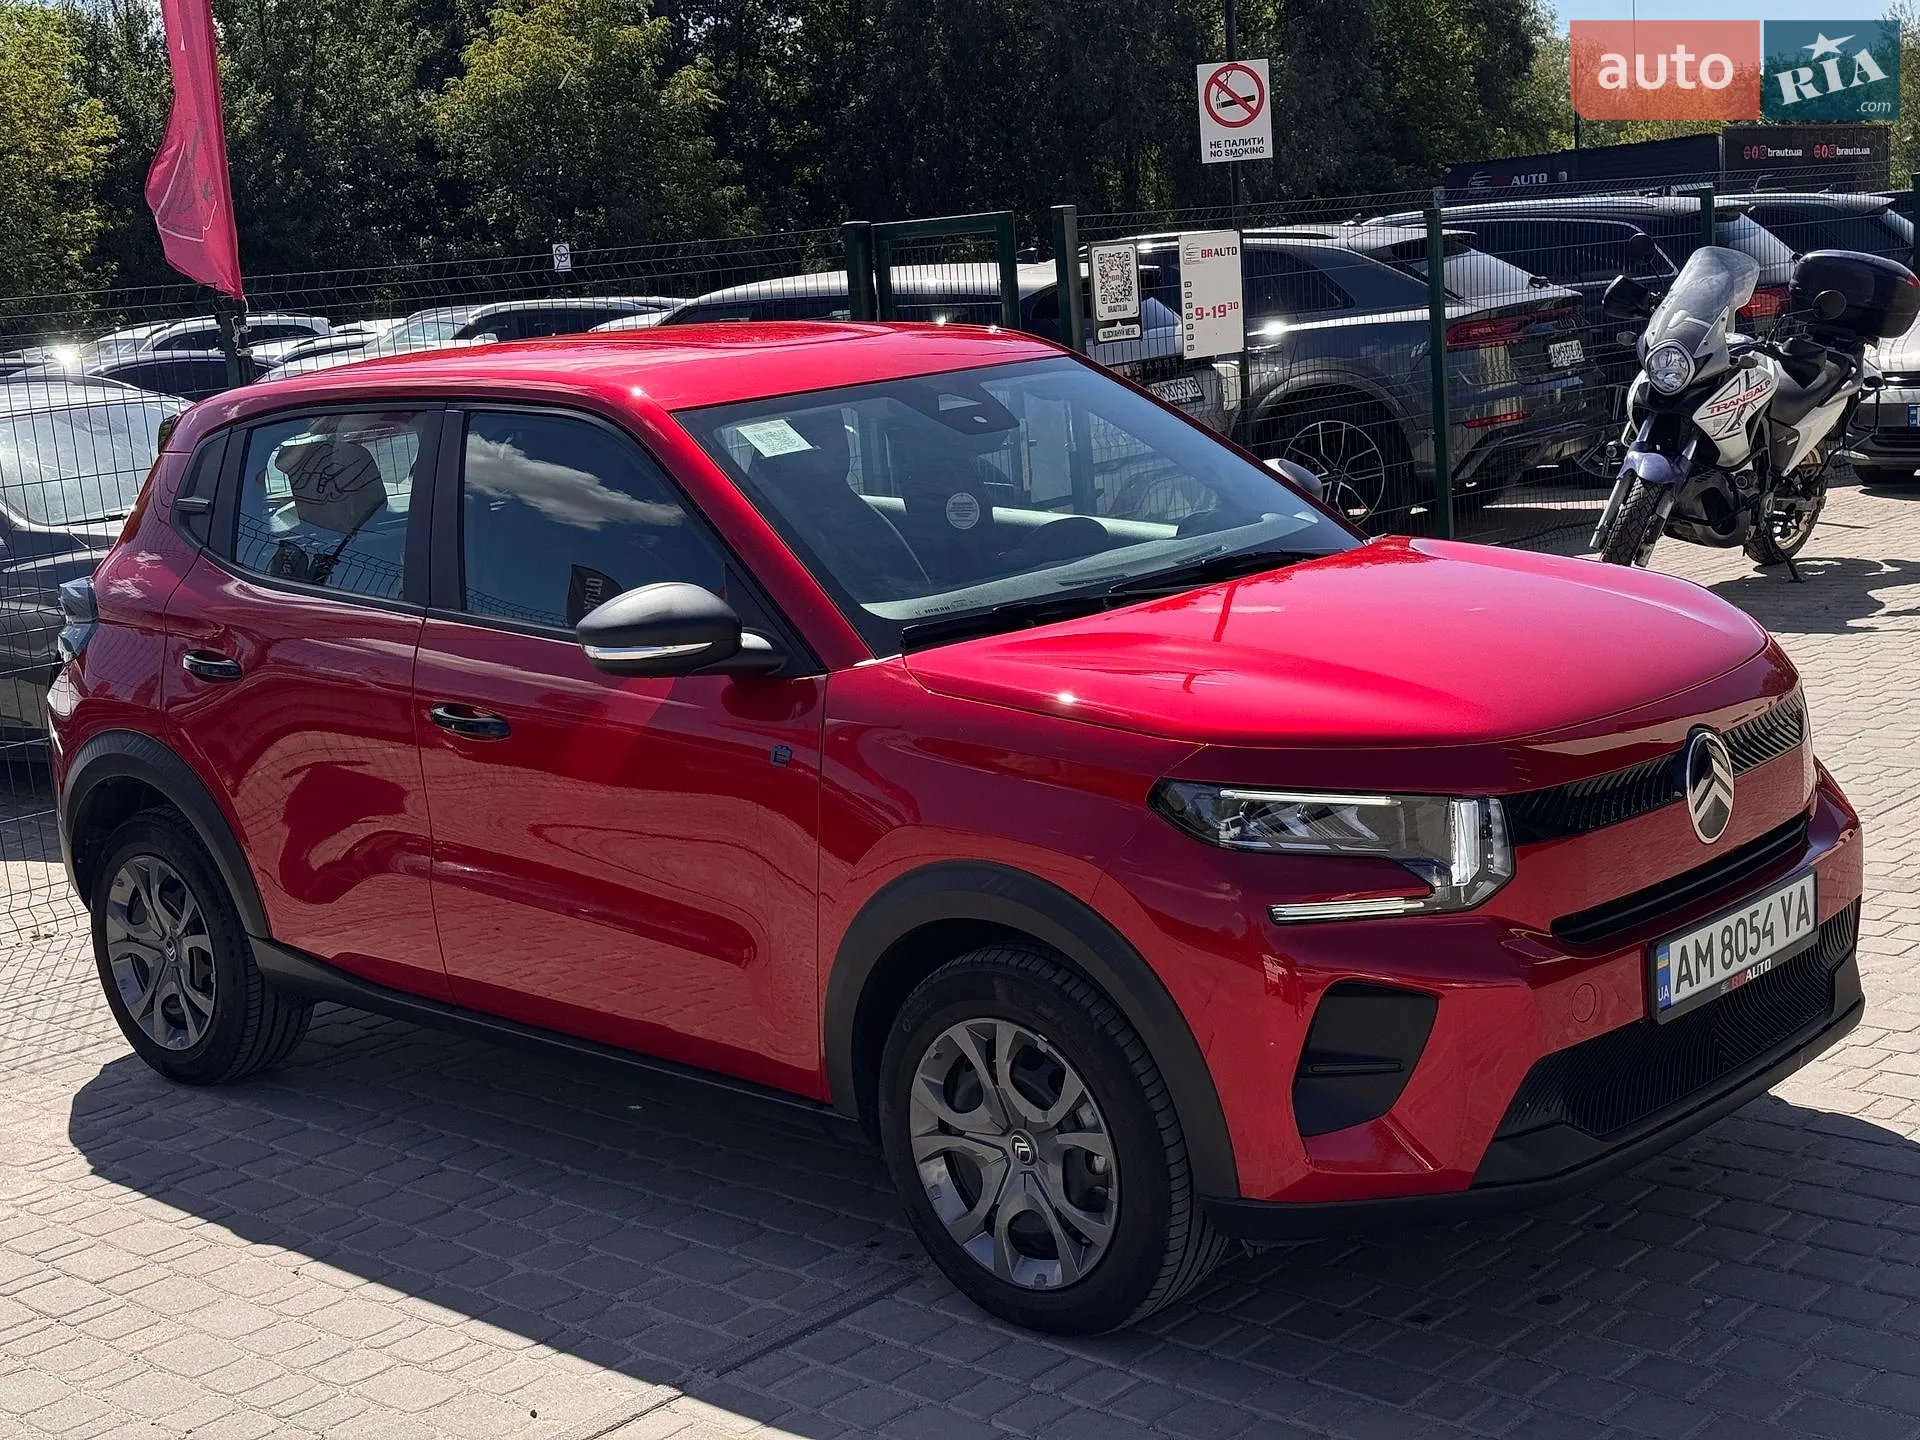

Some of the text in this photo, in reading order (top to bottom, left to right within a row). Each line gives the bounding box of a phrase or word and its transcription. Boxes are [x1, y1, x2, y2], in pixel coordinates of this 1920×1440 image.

[1209, 136, 1264, 149] НЕ ПАЛИТИ
[1210, 145, 1265, 157] NO SMOKING
[1767, 147, 1803, 157] brauto.ua
[1836, 145, 1871, 156] brauto.ua
[1200, 246, 1238, 258] BRAUTO
[1709, 379, 1771, 414] TRANSALP
[1658, 984, 1670, 1001] UA
[1675, 931, 1715, 994] AM
[1720, 902, 1775, 970] 8054
[1731, 958, 1771, 988] BRAUTO
